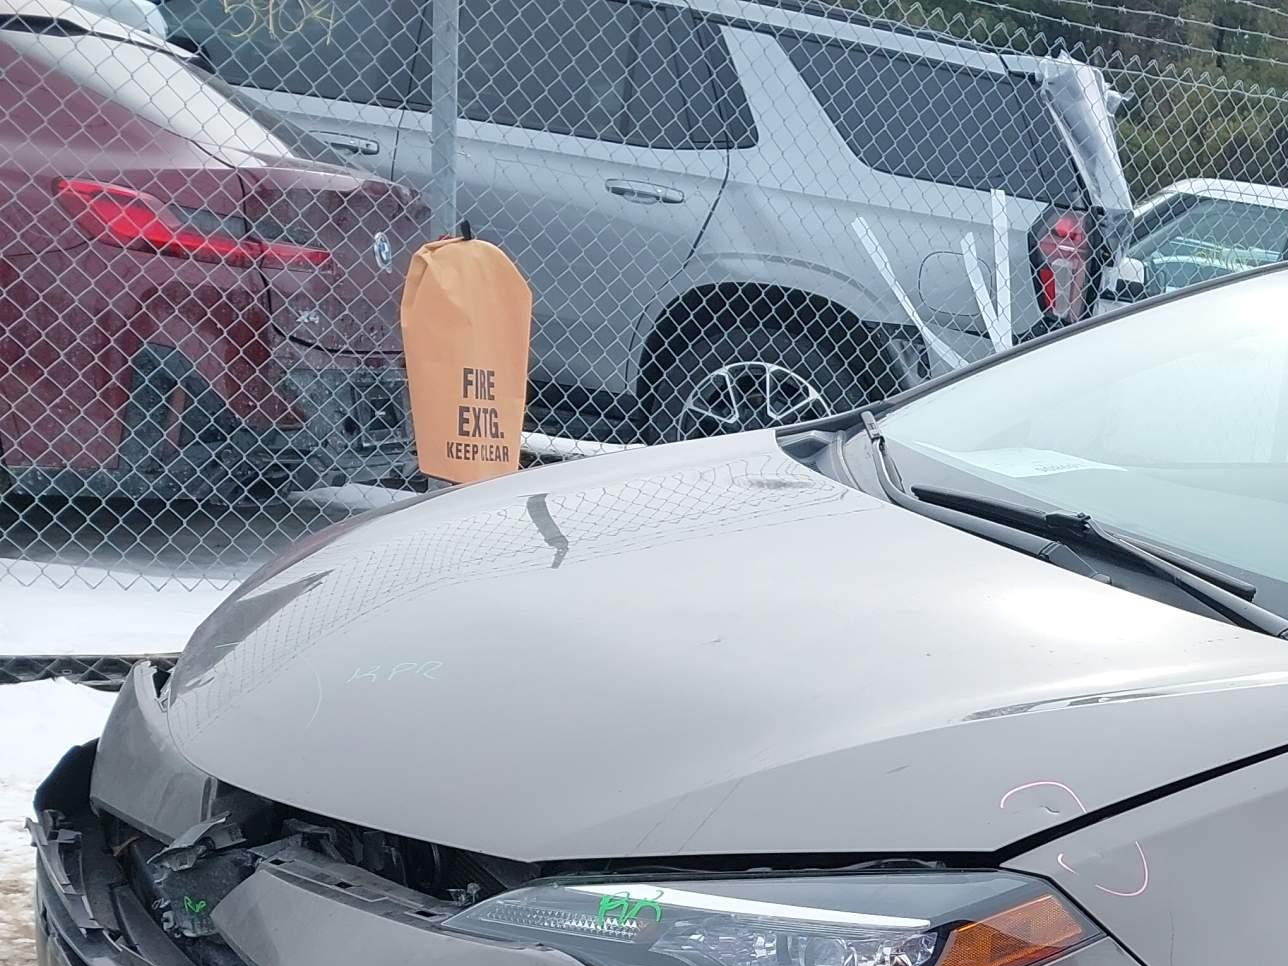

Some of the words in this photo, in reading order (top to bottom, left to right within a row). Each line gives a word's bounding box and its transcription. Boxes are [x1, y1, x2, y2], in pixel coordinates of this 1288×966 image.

[463, 367, 495, 401] FIRE
[458, 405, 505, 438] EXTG.
[447, 441, 479, 461] KEEP
[481, 444, 509, 462] CLEAR
